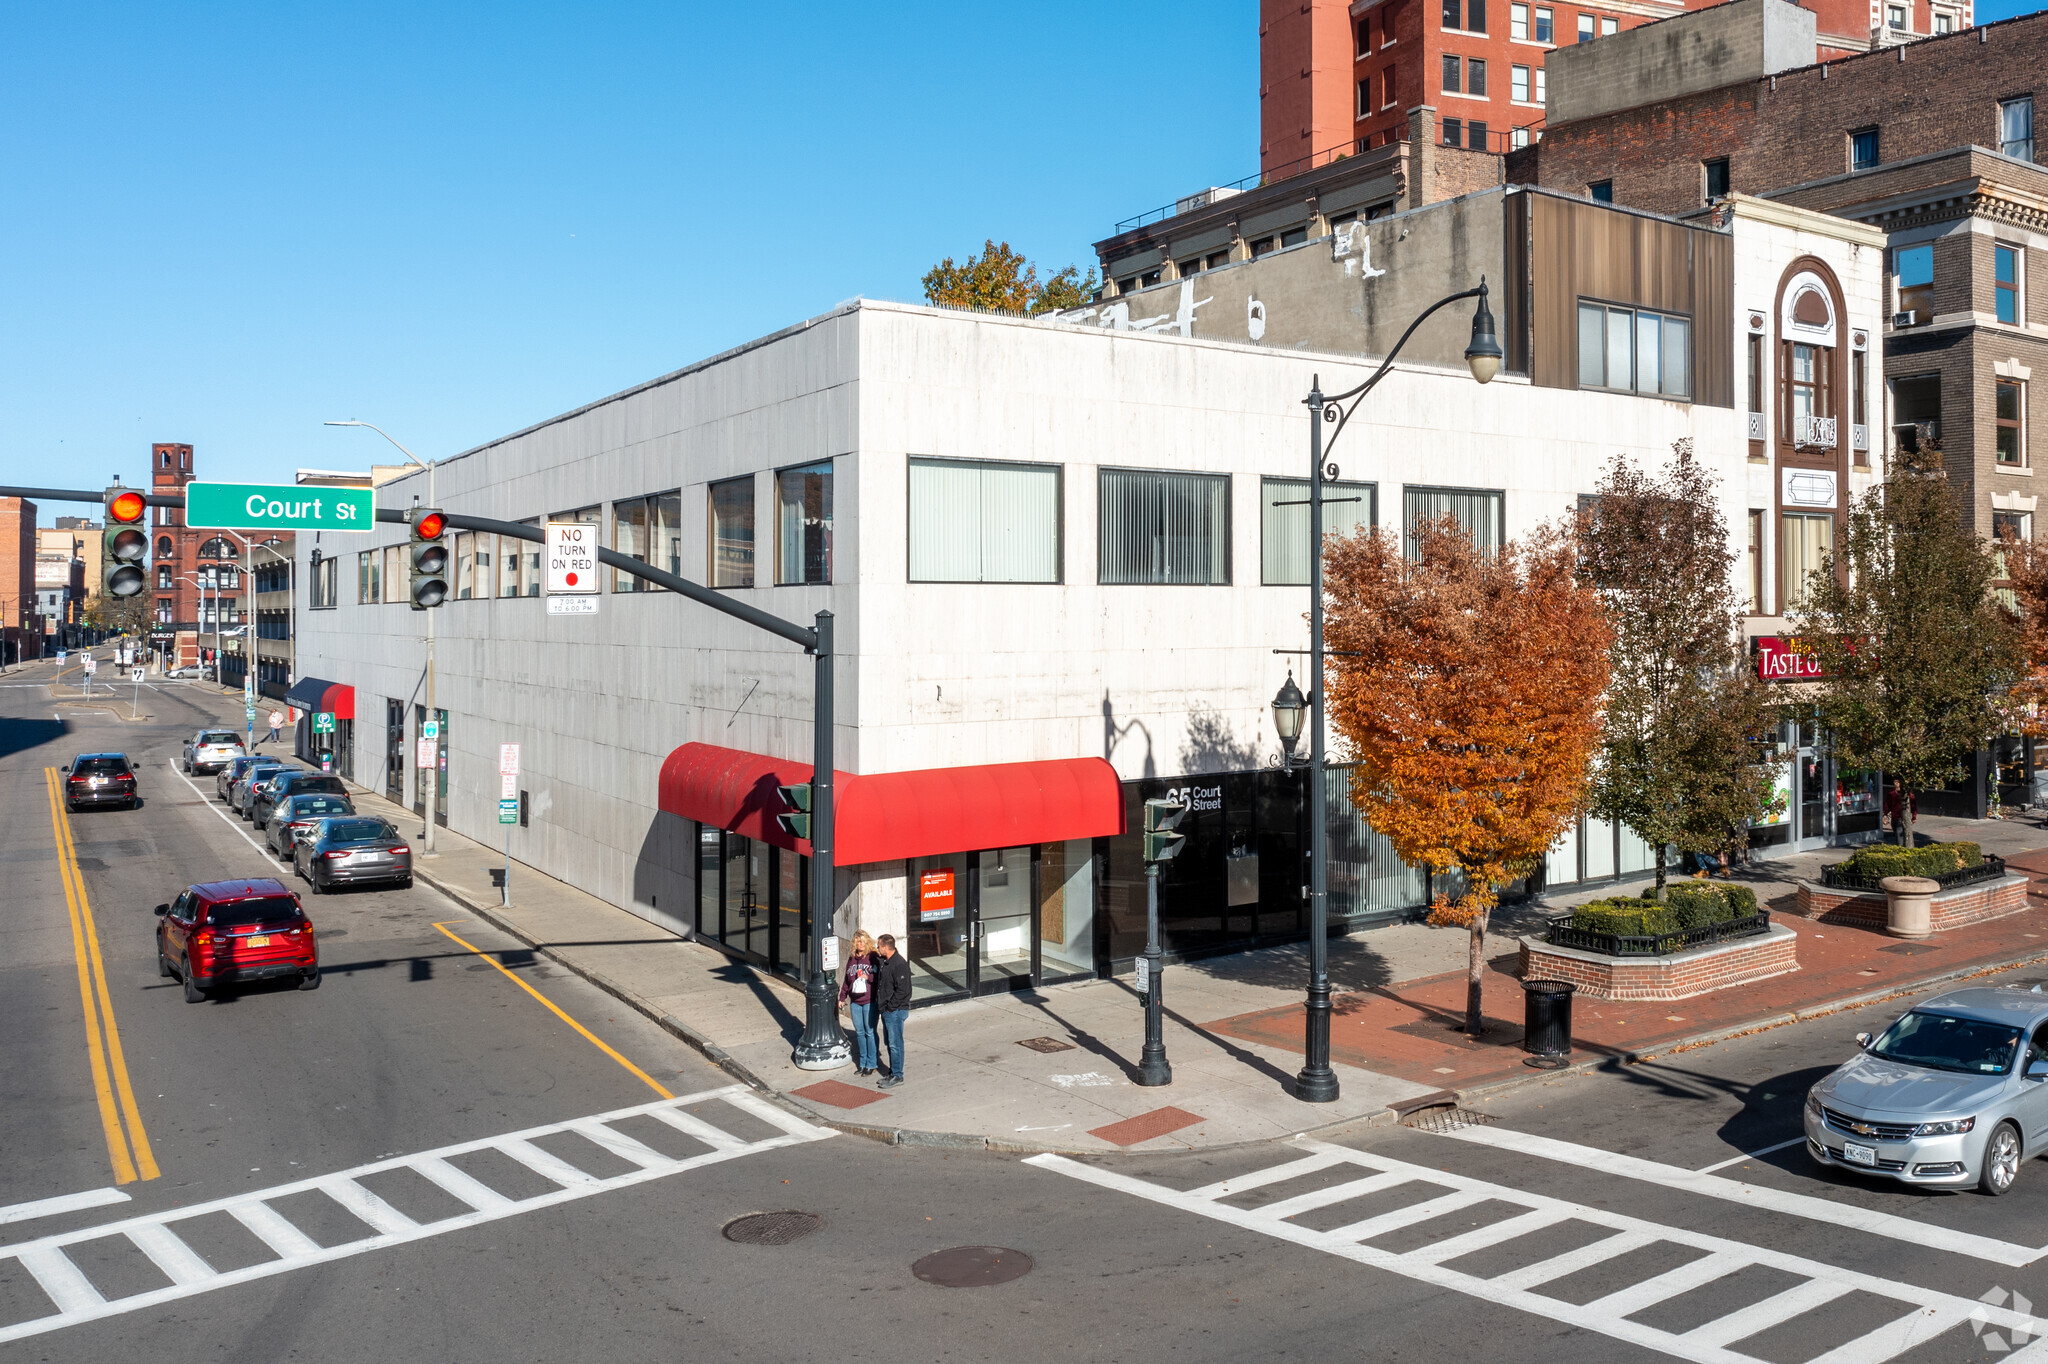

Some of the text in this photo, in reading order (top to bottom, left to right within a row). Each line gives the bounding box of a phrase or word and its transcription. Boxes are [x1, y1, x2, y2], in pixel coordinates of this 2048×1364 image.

[246, 494, 357, 521] Court St
[561, 529, 582, 541] NO
[558, 545, 586, 556] TURN
[551, 559, 592, 570] ON RED
[1193, 785, 1221, 799] Court
[1165, 787, 1192, 812] 65
[1193, 798, 1221, 811] Street
[924, 889, 953, 898] AVAILABLE
